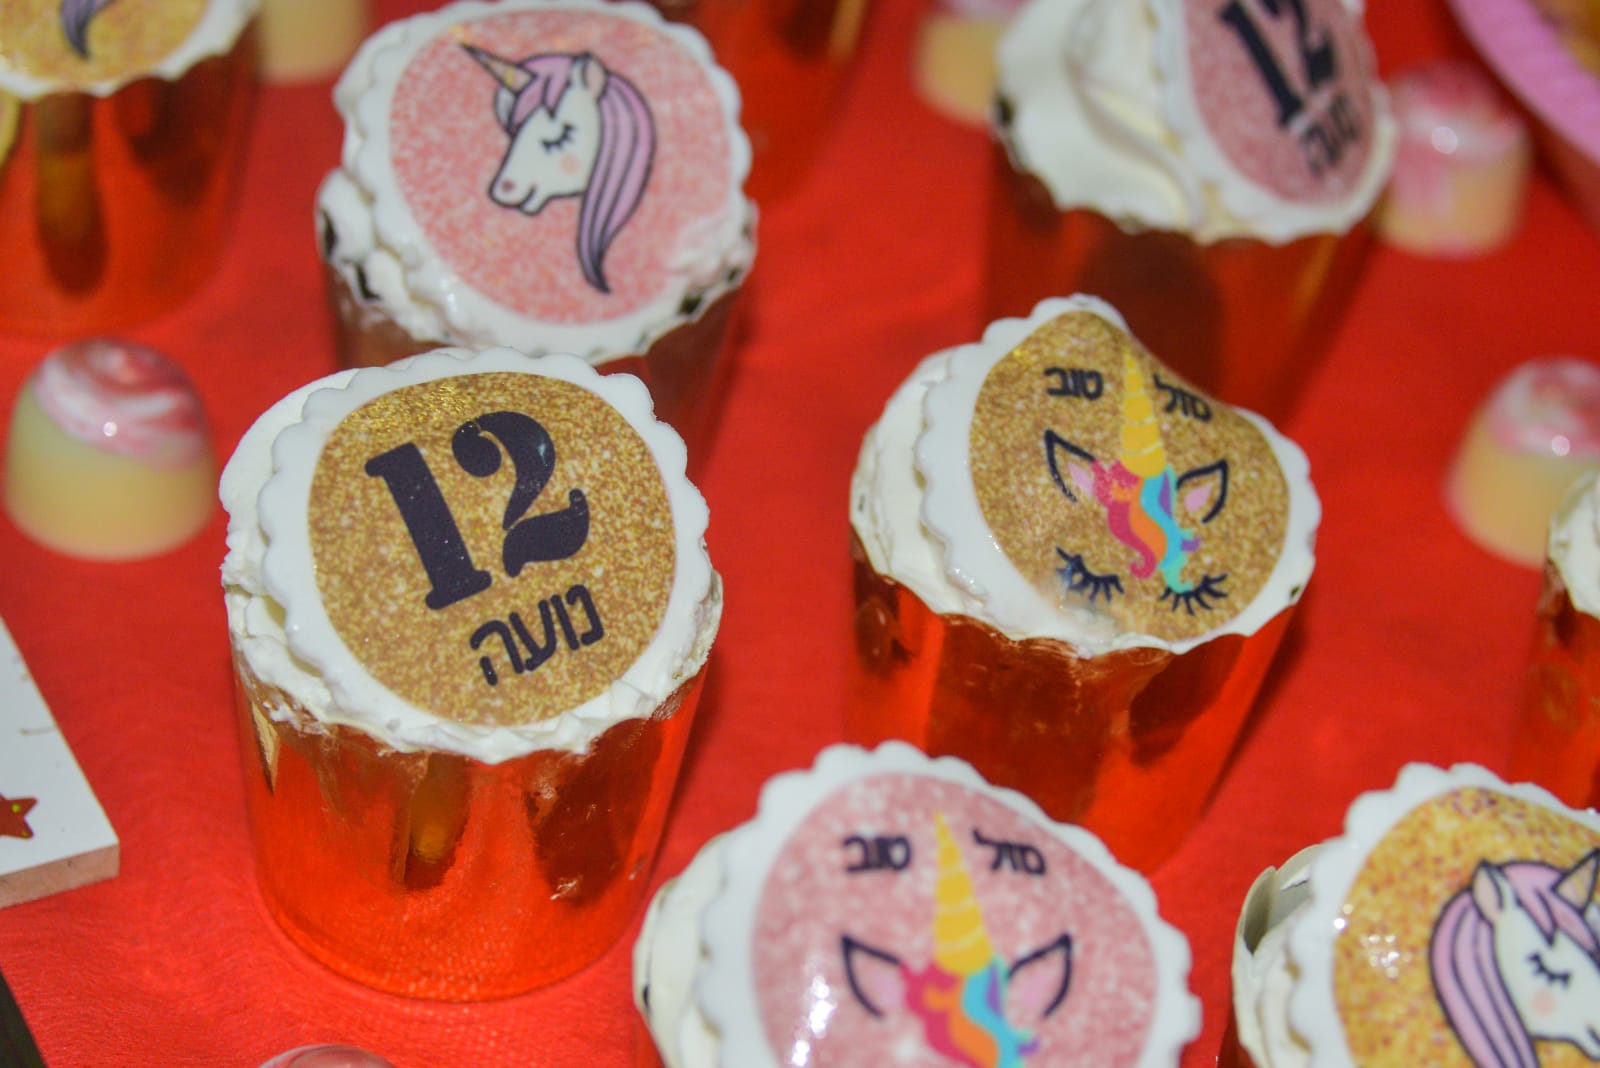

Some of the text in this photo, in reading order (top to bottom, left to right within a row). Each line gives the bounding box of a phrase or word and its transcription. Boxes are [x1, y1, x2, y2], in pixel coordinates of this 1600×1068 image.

[1219, 0, 1337, 129] 12
[1043, 366, 1104, 401] טוב
[364, 411, 590, 610] 12
[470, 584, 605, 686] נועה
[843, 834, 911, 873] טוב
